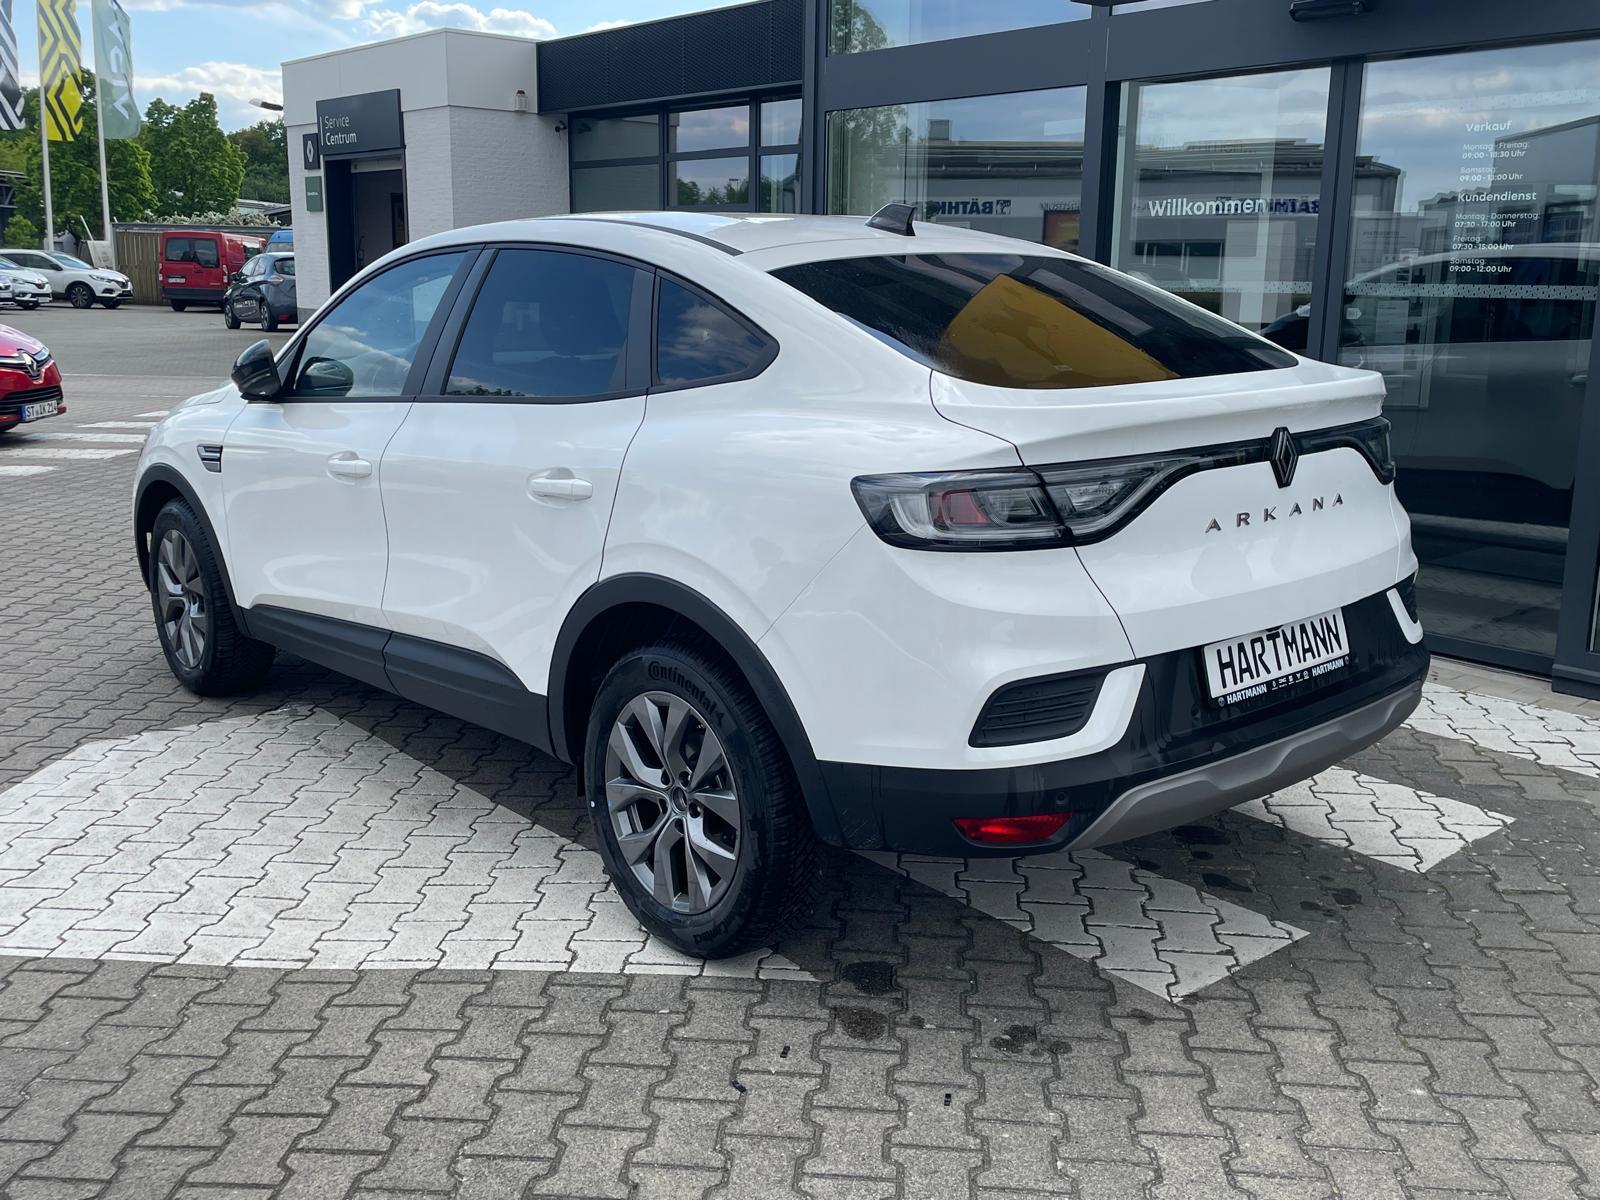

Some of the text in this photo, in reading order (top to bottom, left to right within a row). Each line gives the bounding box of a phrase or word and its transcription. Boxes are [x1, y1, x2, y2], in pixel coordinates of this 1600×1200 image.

[324, 115, 350, 129] Service
[1465, 120, 1512, 132] Verkauf
[325, 132, 357, 146] Centrum
[1463, 143, 1493, 152] Montag
[1511, 149, 1526, 158] Uhr
[1508, 172, 1524, 180] Uhr
[1458, 191, 1537, 202] Kundendienst
[1149, 198, 1267, 216] Willkommen
[1502, 220, 1517, 228] Uhr
[1500, 242, 1515, 250] Uhr
[1497, 264, 1512, 273] Uhr
[26, 405, 36, 418] ST
[1205, 493, 1344, 533] ARKANA
[1216, 613, 1342, 689] HARTMANN
[647, 660, 717, 714] Continental
[1226, 659, 1344, 705] HARTMANN HARTMANN
